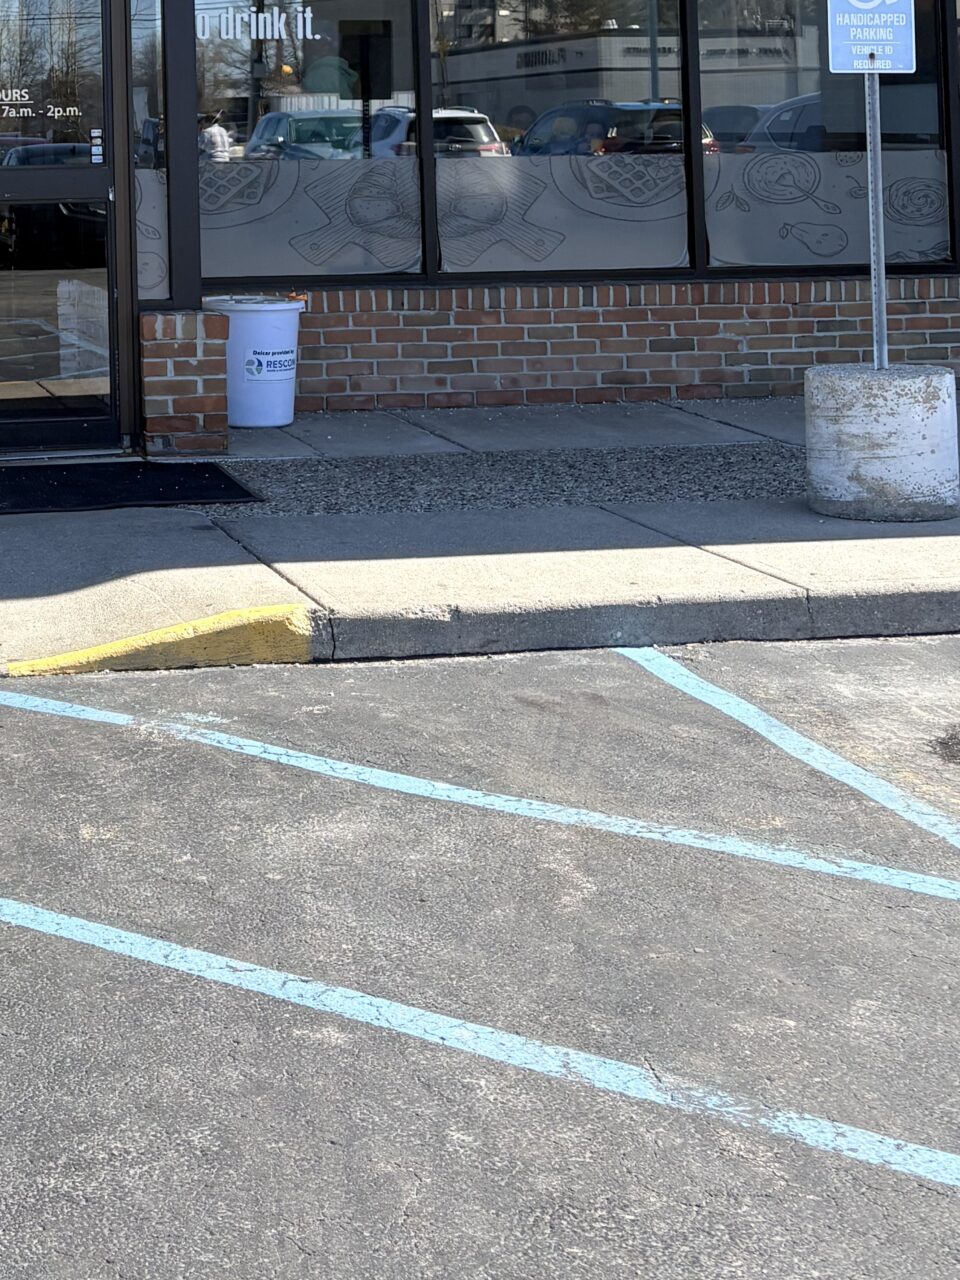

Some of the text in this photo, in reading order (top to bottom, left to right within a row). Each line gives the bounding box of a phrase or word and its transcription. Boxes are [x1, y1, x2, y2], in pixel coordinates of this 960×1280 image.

[196, 6, 321, 40] o drink it.
[836, 13, 906, 26] HANDICAPPED
[850, 27, 893, 40] PARKING
[851, 45, 893, 55] VEHICLE ID
[854, 60, 892, 69] REQUIRED
[1, 106, 36, 118] 7a.m.
[46, 105, 83, 119] 2p.m.
